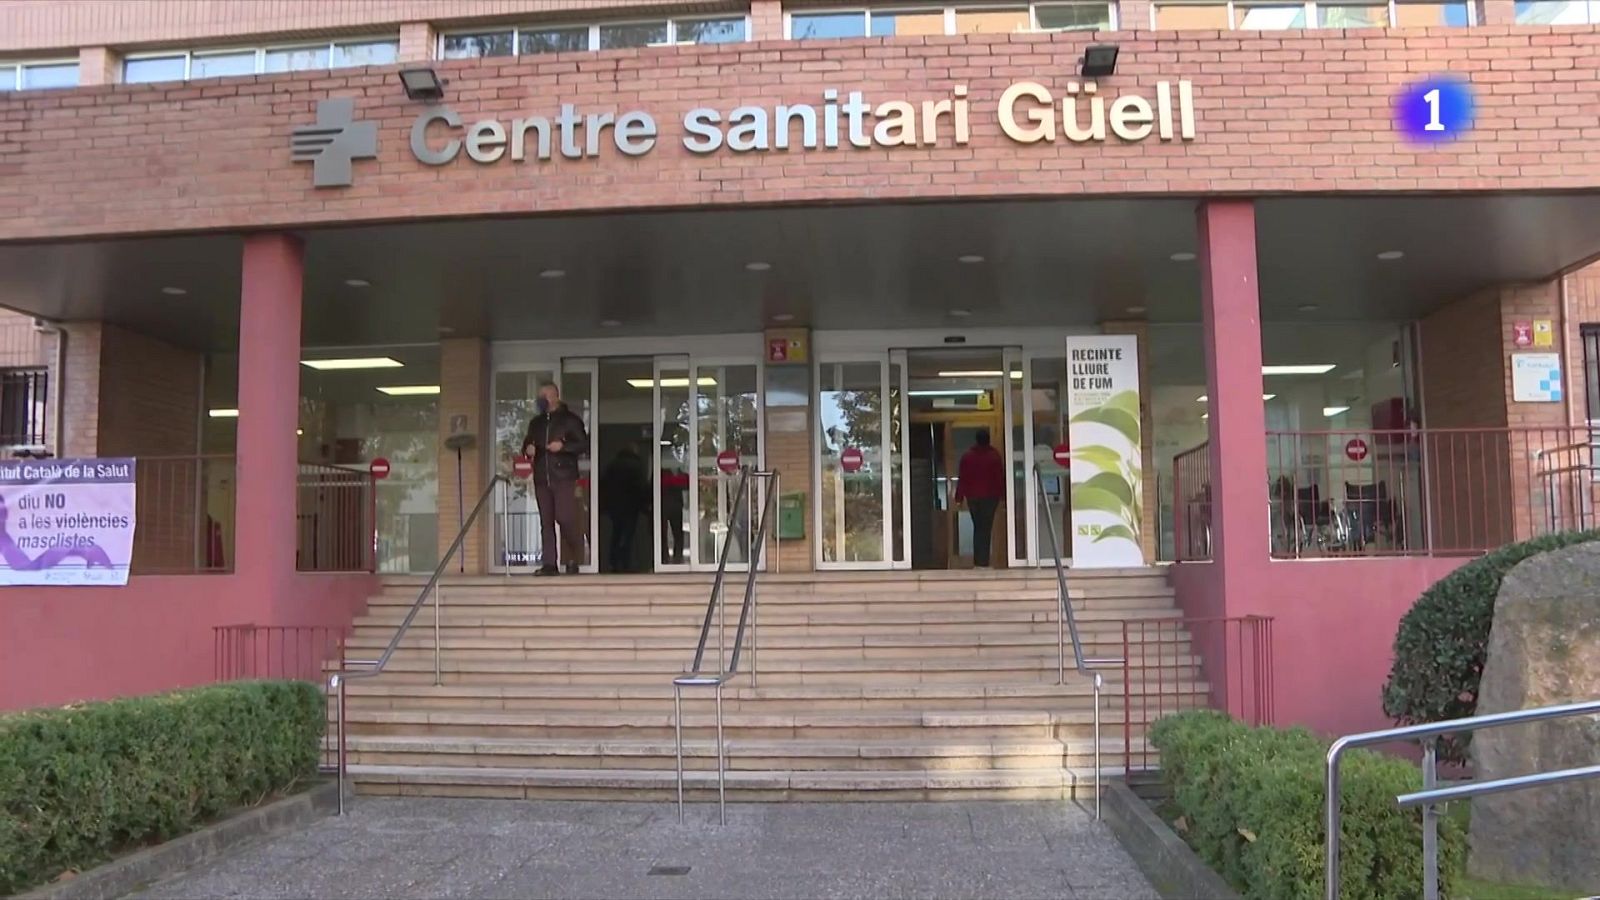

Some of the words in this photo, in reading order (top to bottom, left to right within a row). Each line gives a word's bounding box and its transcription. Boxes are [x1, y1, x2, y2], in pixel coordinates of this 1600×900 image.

[410, 103, 658, 166] Centre
[682, 85, 970, 153] sanitari
[998, 80, 1195, 143] Güell
[1072, 348, 1122, 361] RECINTE
[1072, 363, 1110, 375] LLIURE
[1073, 378, 1087, 390] DE
[1089, 377, 1113, 390] FUM
[23, 465, 62, 480] Català
[64, 465, 80, 479] de
[83, 464, 95, 478] la
[97, 464, 129, 478] Salut
[18, 494, 40, 510] diu
[45, 493, 66, 509] NO
[18, 517, 27, 529] a
[31, 513, 52, 529] les
[55, 512, 129, 529] violències
[17, 532, 96, 549] masclistes
